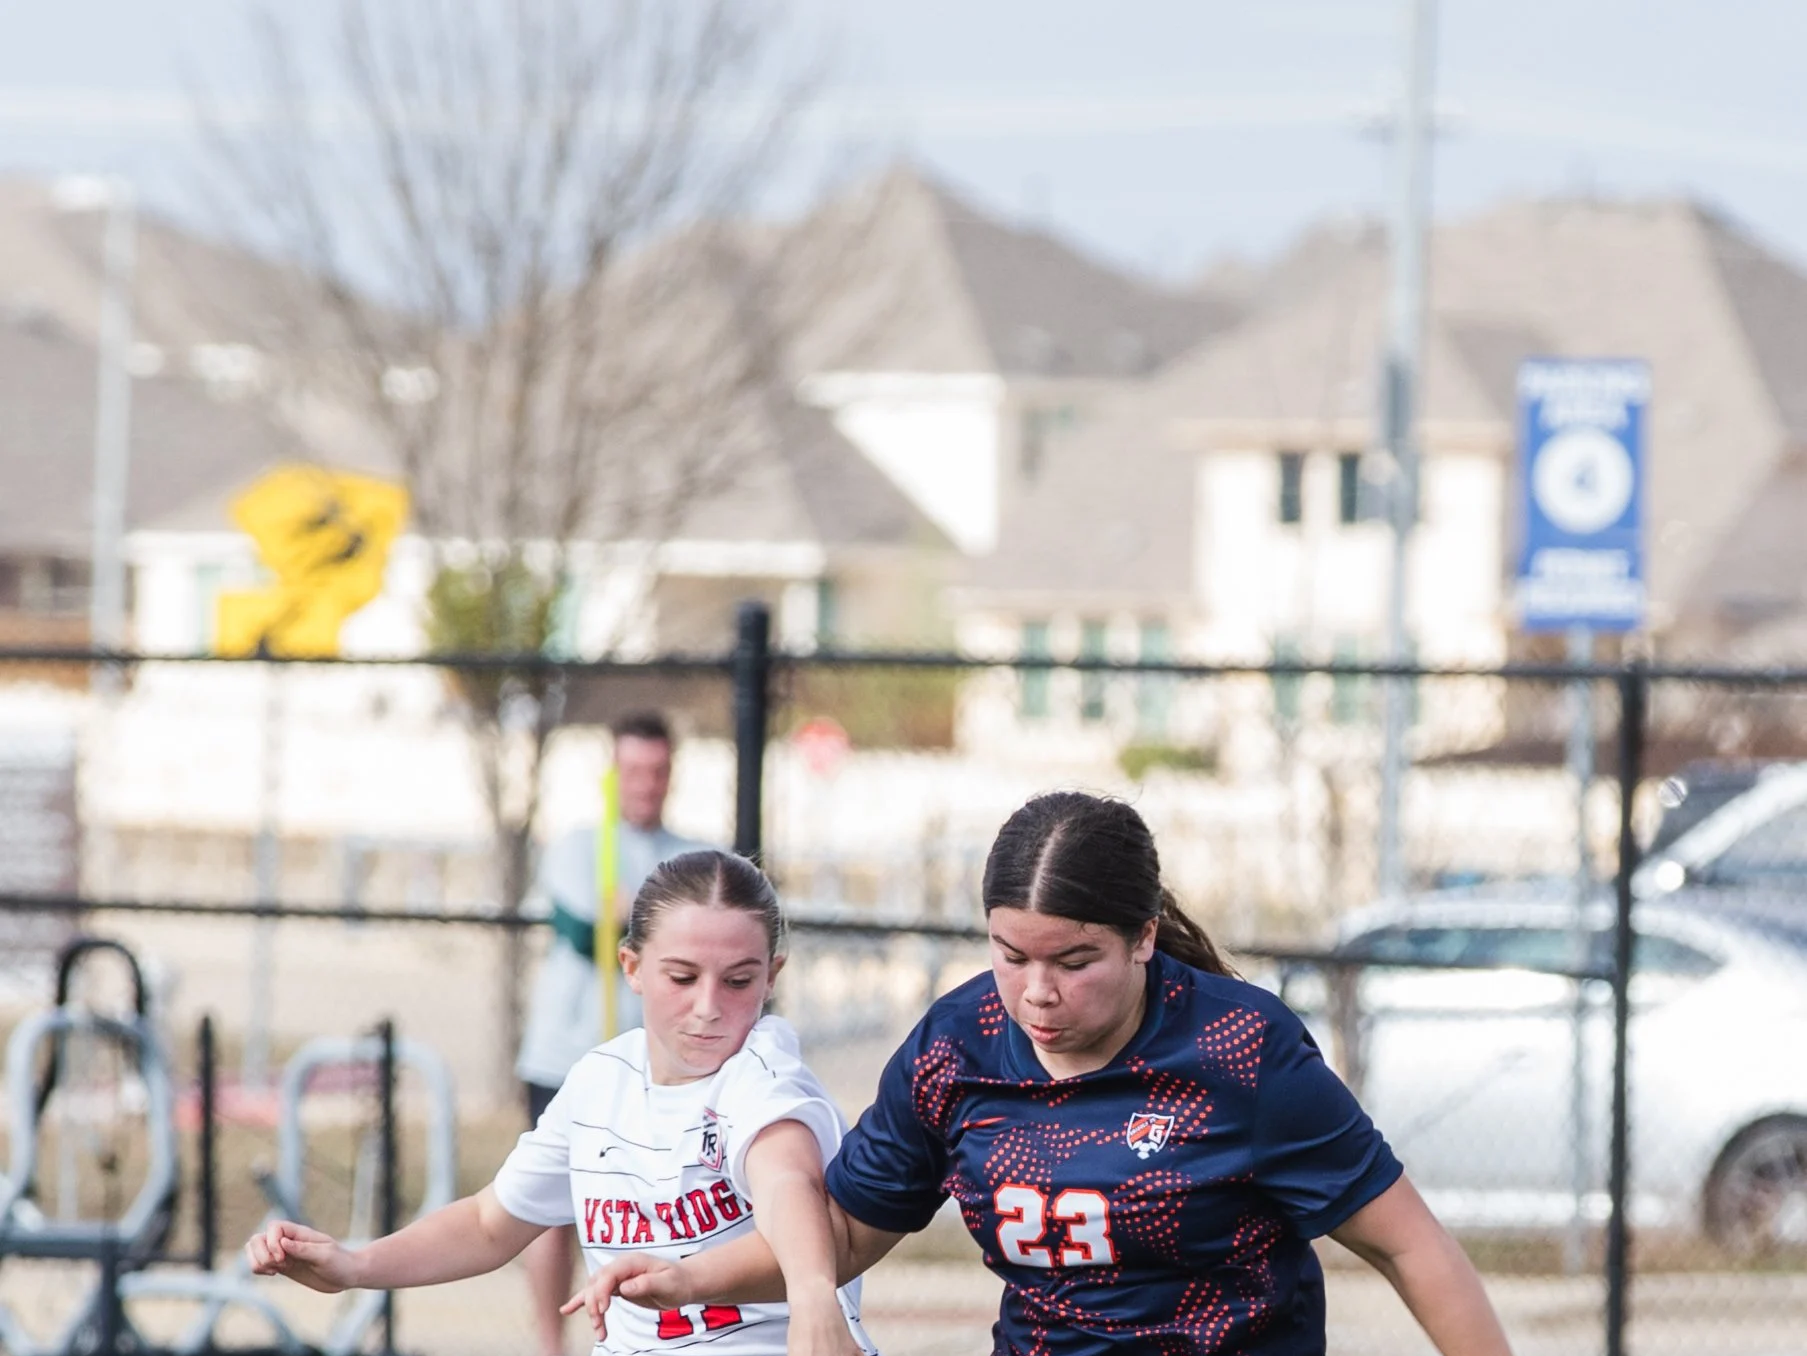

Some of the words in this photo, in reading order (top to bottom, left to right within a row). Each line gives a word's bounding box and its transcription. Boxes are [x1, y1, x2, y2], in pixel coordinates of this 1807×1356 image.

[585, 1198, 655, 1243] VSTA
[655, 1178, 752, 1240] RIDG
[994, 1184, 1116, 1268] 23
